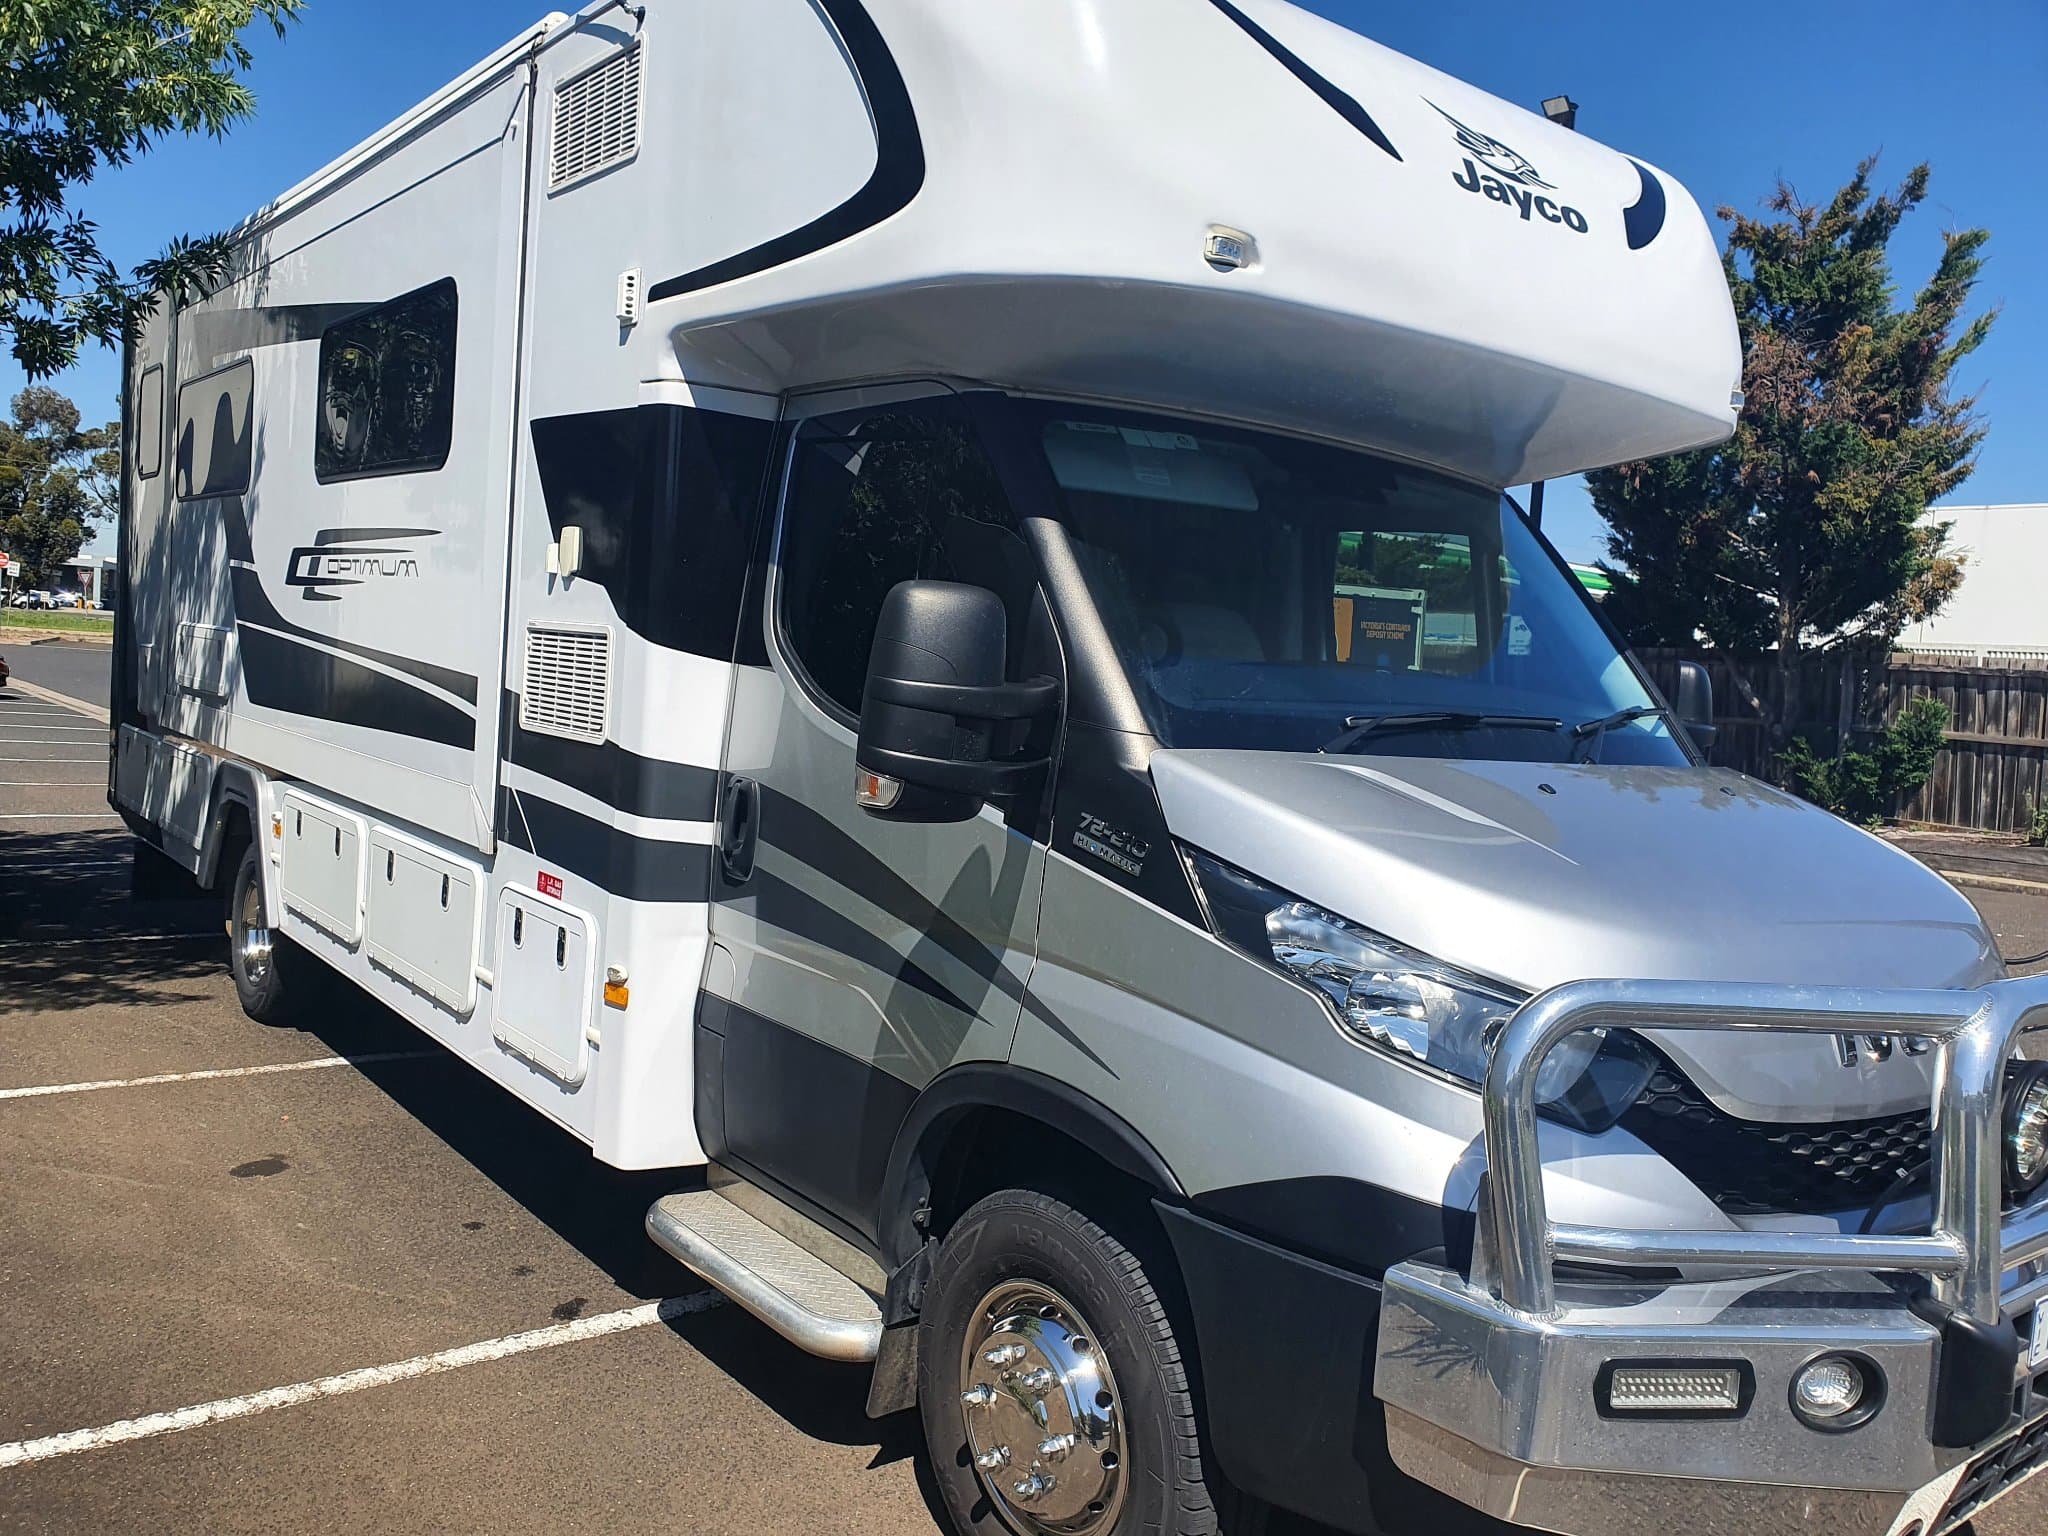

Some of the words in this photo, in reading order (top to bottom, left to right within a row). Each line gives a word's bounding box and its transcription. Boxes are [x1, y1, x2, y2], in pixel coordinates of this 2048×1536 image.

[1452, 157, 1589, 234] Jayco
[327, 558, 419, 577] OPTIMUM
[1366, 630, 1386, 639] DEPOSIT
